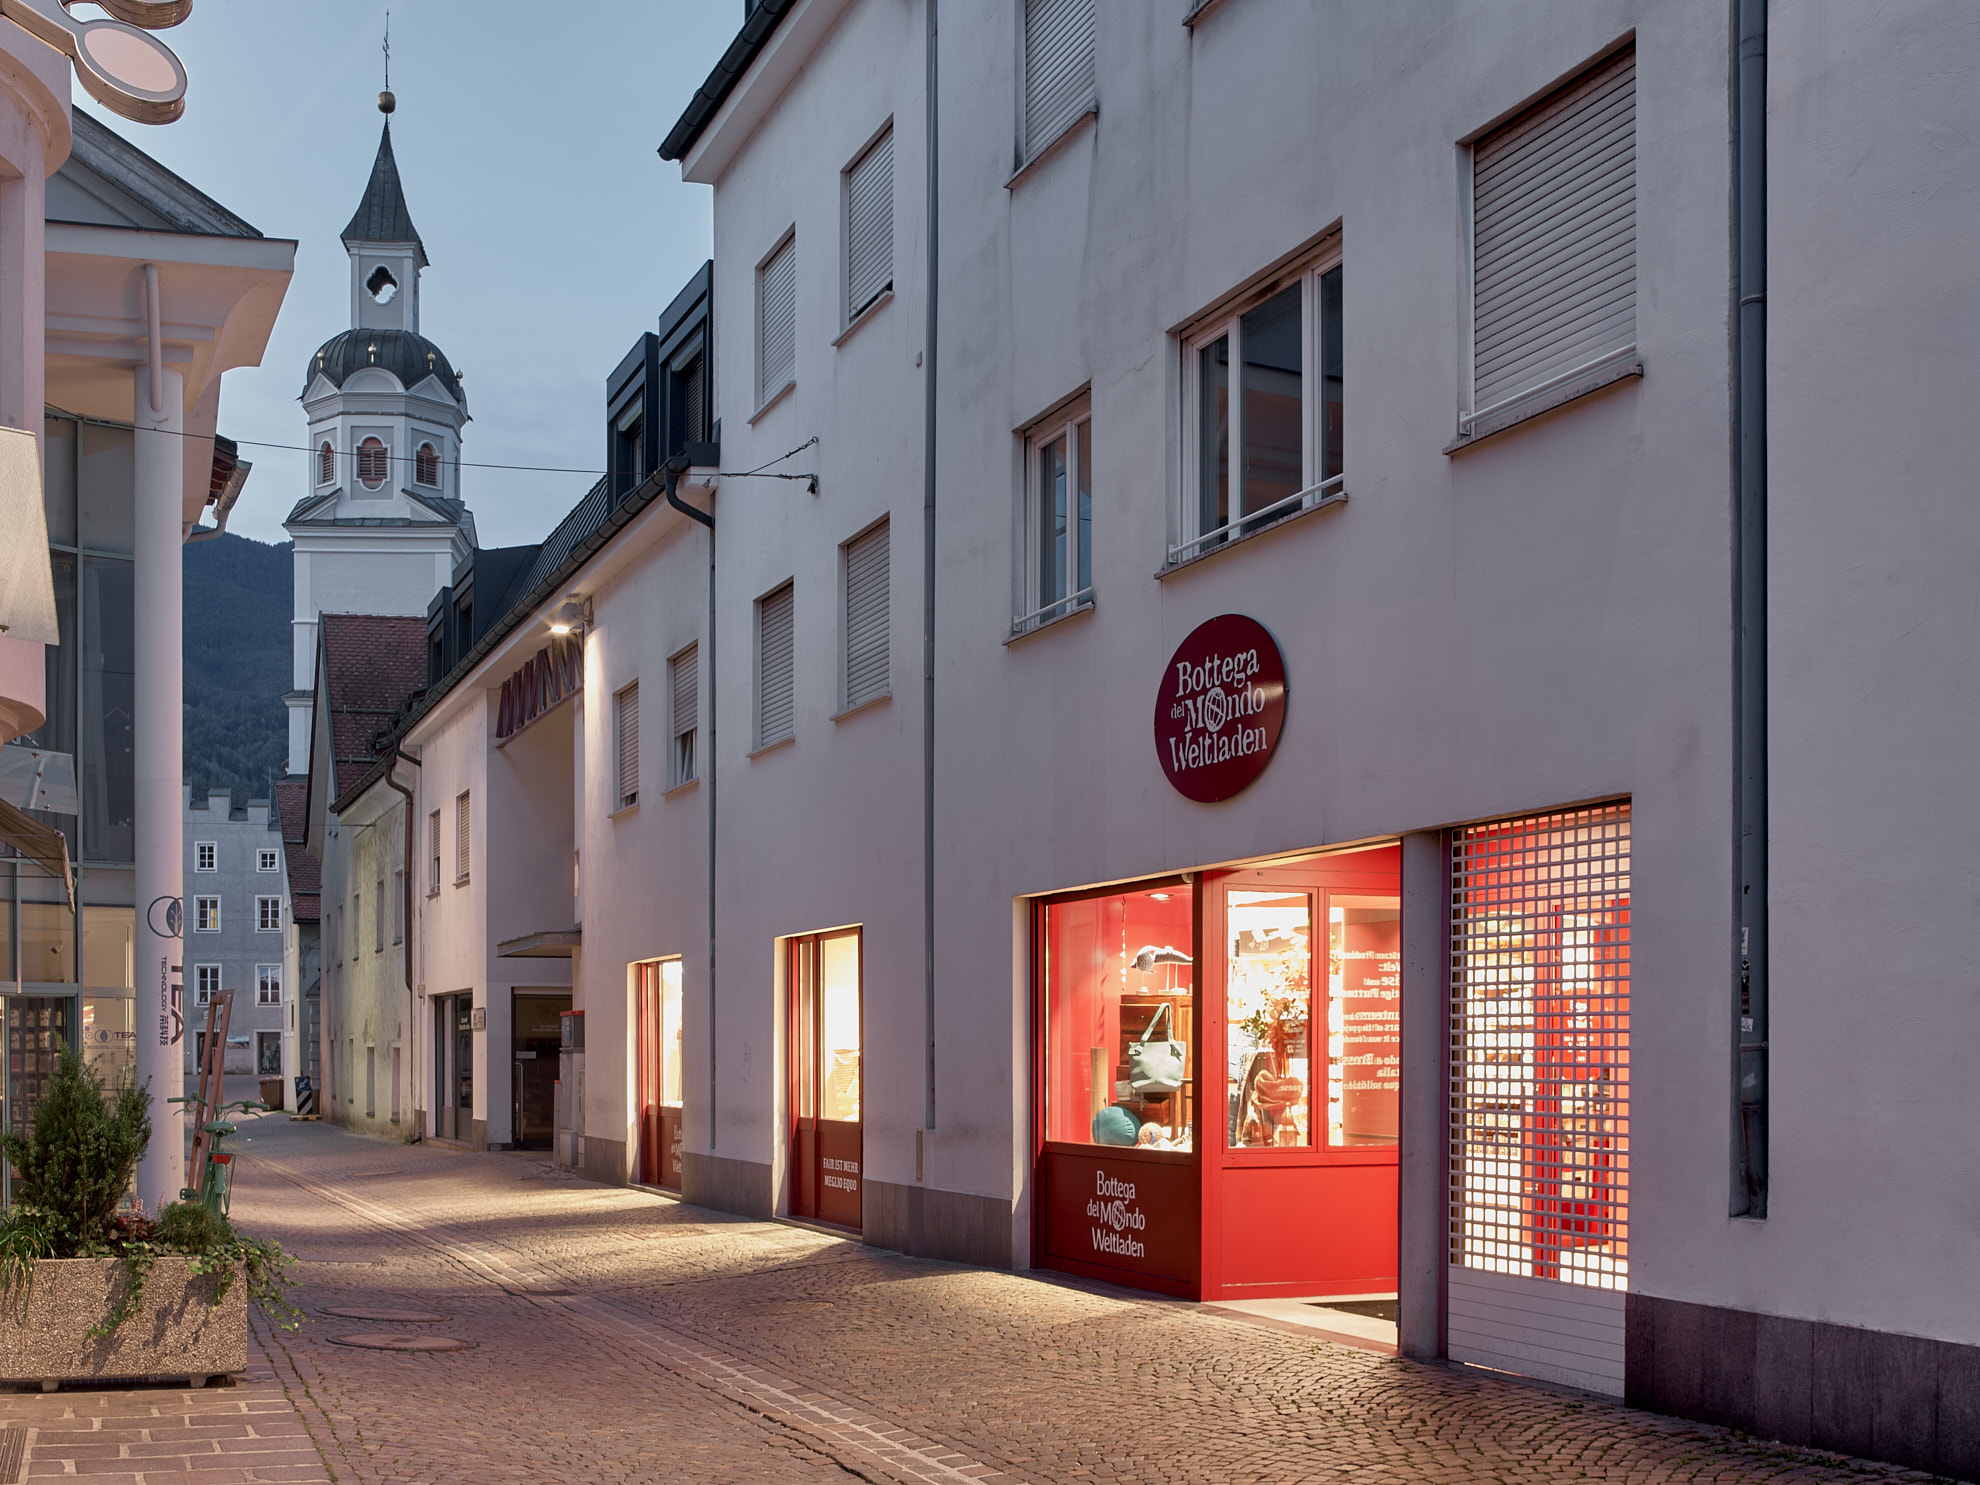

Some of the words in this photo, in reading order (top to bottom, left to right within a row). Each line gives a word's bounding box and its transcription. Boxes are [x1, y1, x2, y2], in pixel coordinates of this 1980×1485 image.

[1176, 649, 1259, 697] Bottega
[1171, 702, 1185, 719] del
[1184, 682, 1265, 733] Mondo
[1169, 723, 1267, 772] Weltladen
[823, 1157, 834, 1169] FAIR
[834, 1159, 844, 1171] IST
[843, 1160, 859, 1173] MEHR
[824, 1175, 843, 1188] MEGLIO
[843, 1178, 857, 1192] EQUO
[1096, 1170, 1135, 1204] Bottega
[1086, 1198, 1099, 1217] del
[1100, 1200, 1145, 1231] Mondo
[1091, 1227, 1144, 1257] Weltladen
